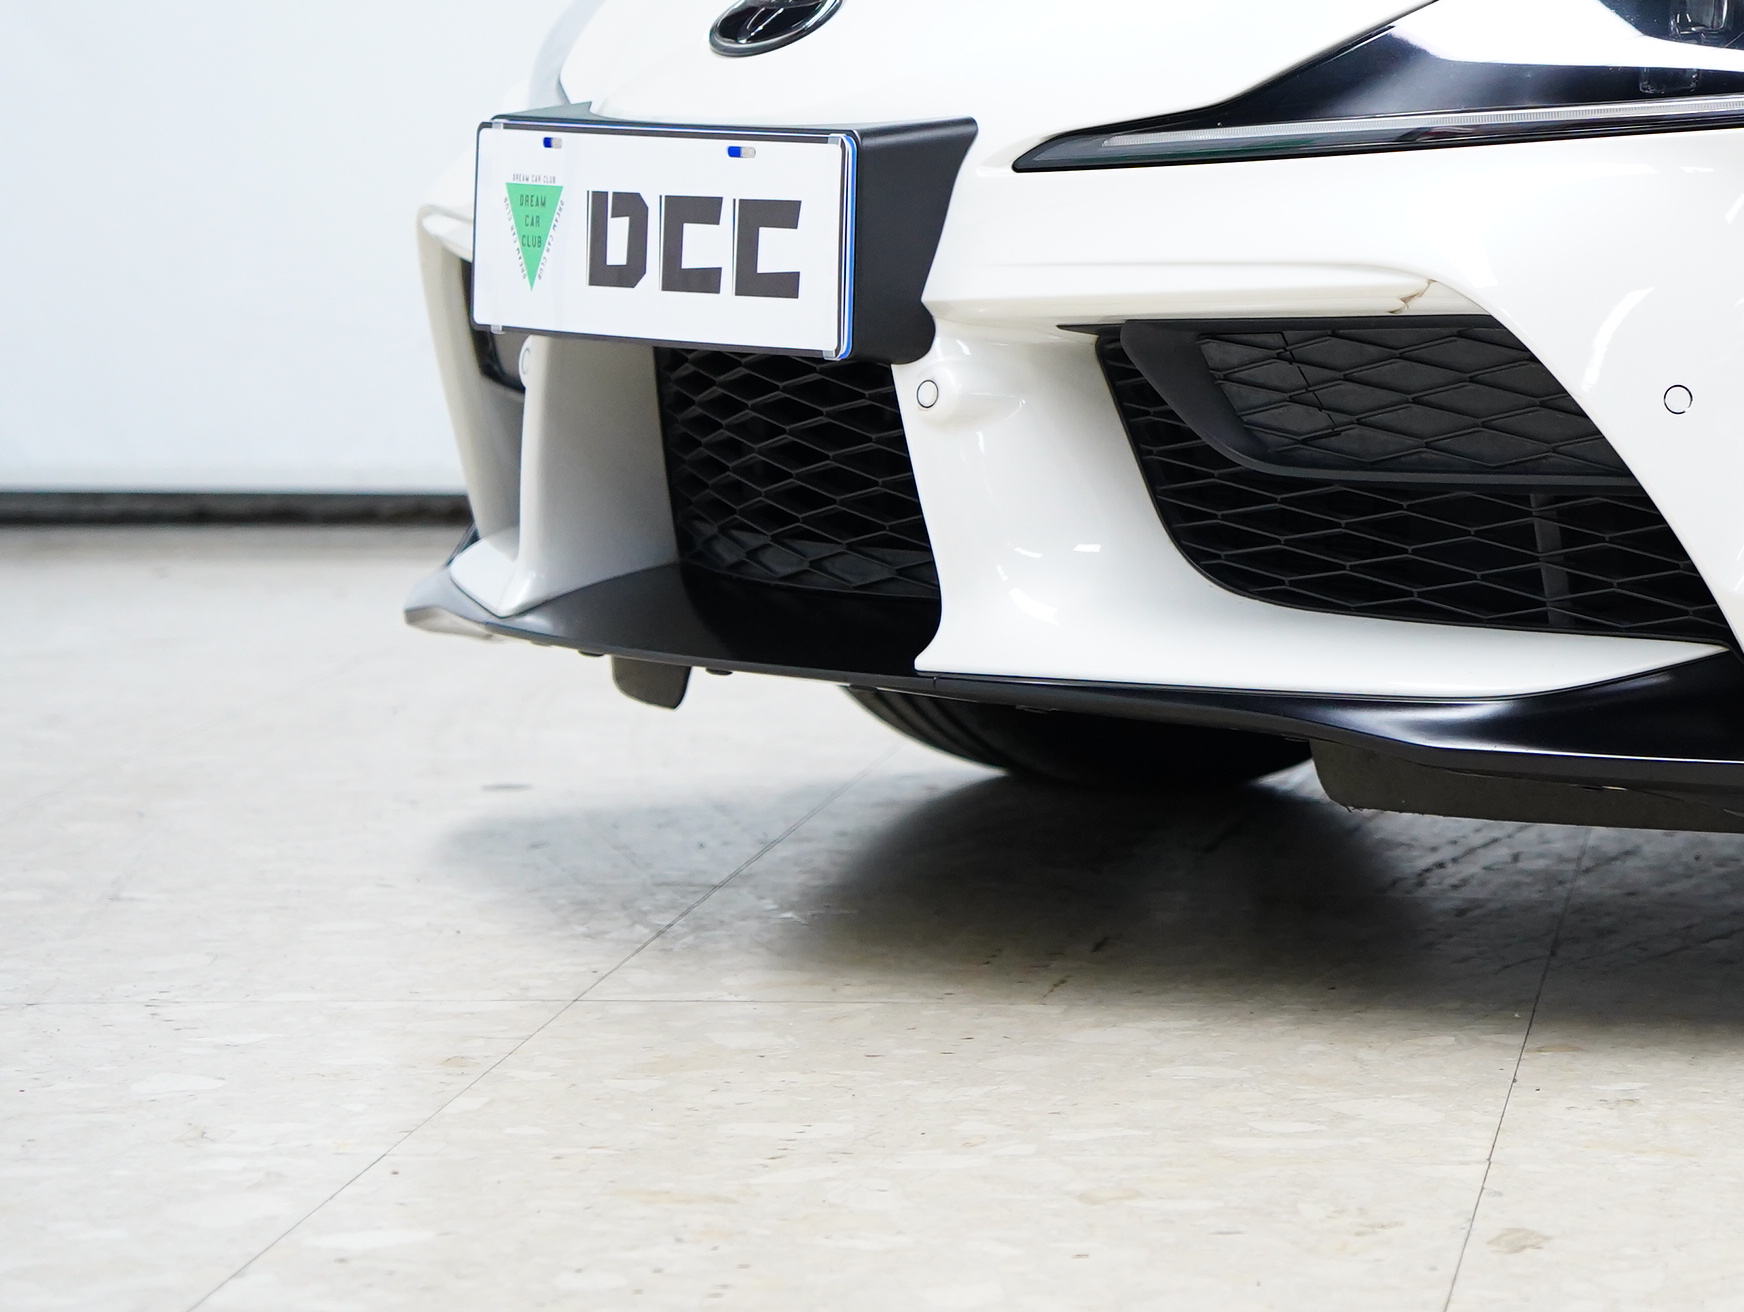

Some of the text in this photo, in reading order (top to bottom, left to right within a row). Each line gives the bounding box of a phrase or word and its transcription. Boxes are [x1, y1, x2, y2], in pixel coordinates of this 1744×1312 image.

[512, 173, 556, 184] DREAM CAR CLUB
[520, 194, 547, 208] DREAM
[524, 214, 541, 227] CAR
[521, 234, 542, 248] CLUB
[586, 190, 802, 299] DCC
